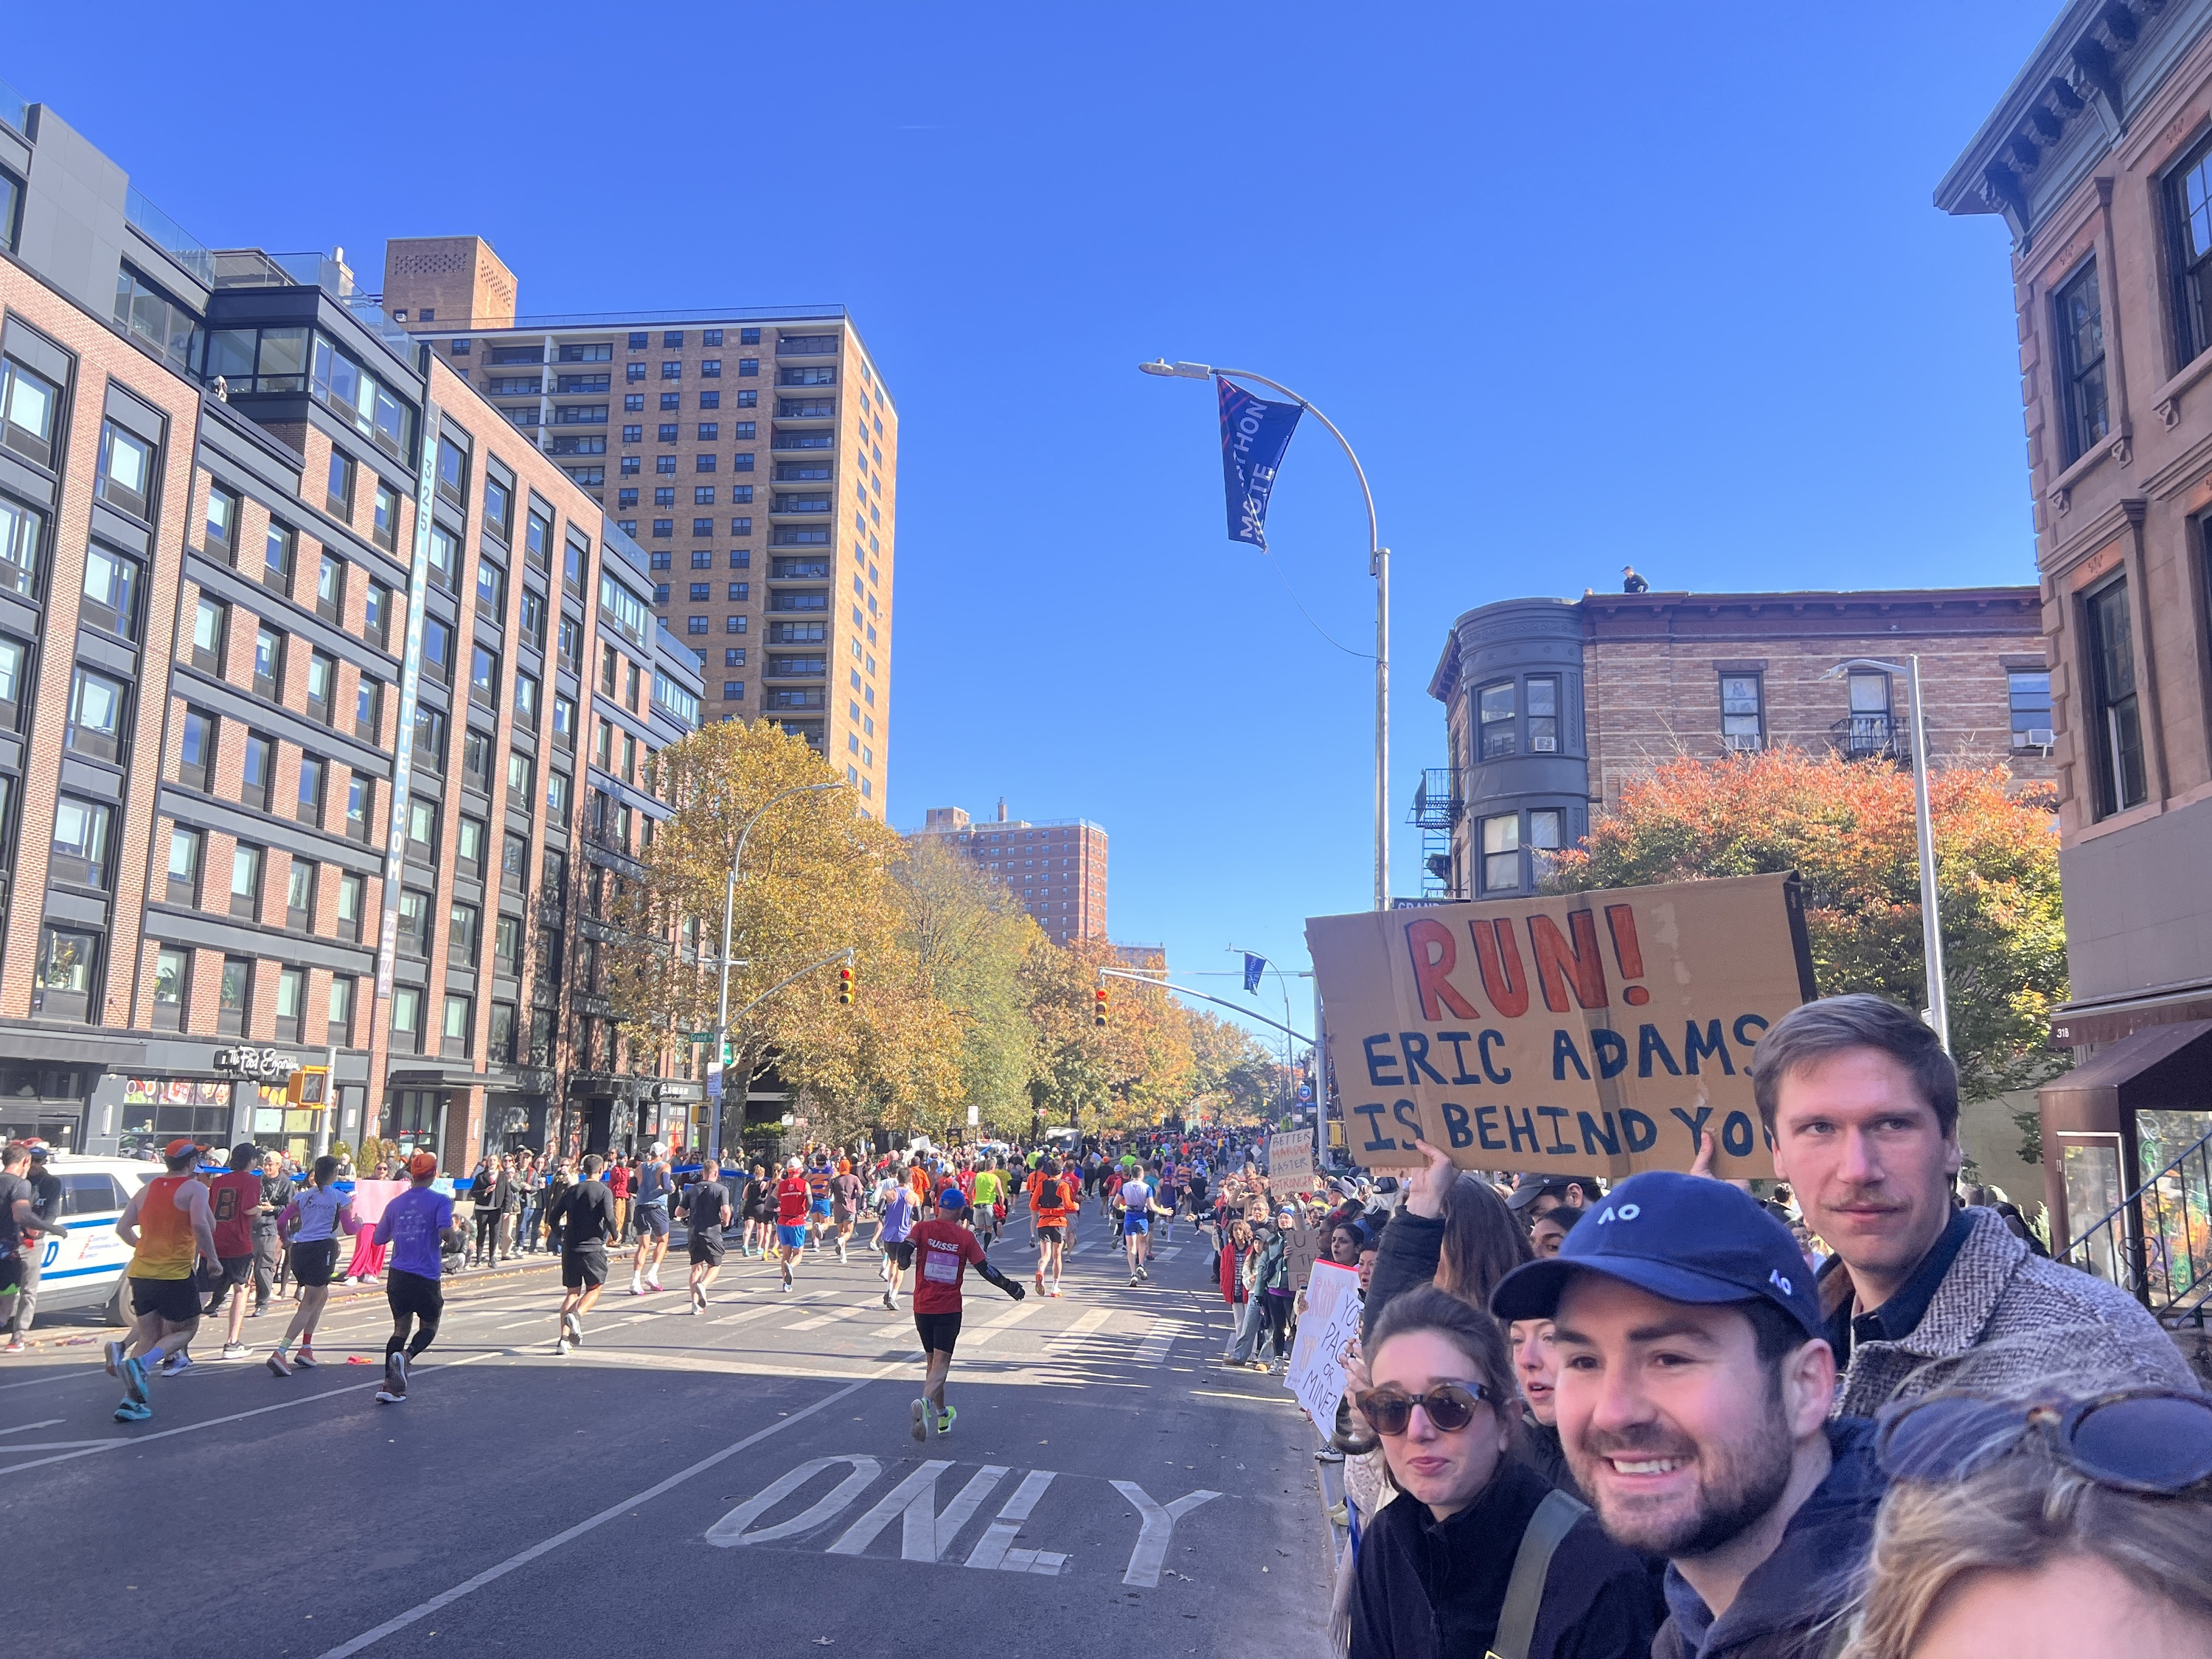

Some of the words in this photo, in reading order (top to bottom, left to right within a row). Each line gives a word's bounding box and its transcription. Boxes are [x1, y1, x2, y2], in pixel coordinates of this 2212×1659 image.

[1405, 904, 1651, 1022] RUN!
[690, 1034, 707, 1042] Grand
[229, 1049, 240, 1066] The
[239, 1045, 259, 1074] Food
[1363, 1029, 1512, 1087] ERIC
[1552, 1013, 1770, 1081] ADAMS
[1354, 1099, 1424, 1152] IS
[1442, 1102, 1658, 1157] BEHIND
[1669, 1106, 1773, 1157] YO
[1273, 1131, 1311, 1148] BETTER
[1272, 1143, 1311, 1160] HARDER
[1272, 1157, 1308, 1176] FASTER
[1271, 1175, 1313, 1192] STRONGER
[928, 1238, 959, 1252] SUISSE
[1298, 1253, 1315, 1267] TH
[1321, 1322, 1348, 1365] PAC
[1324, 1363, 1335, 1386] OR
[703, 1453, 1224, 1587] ONLY
